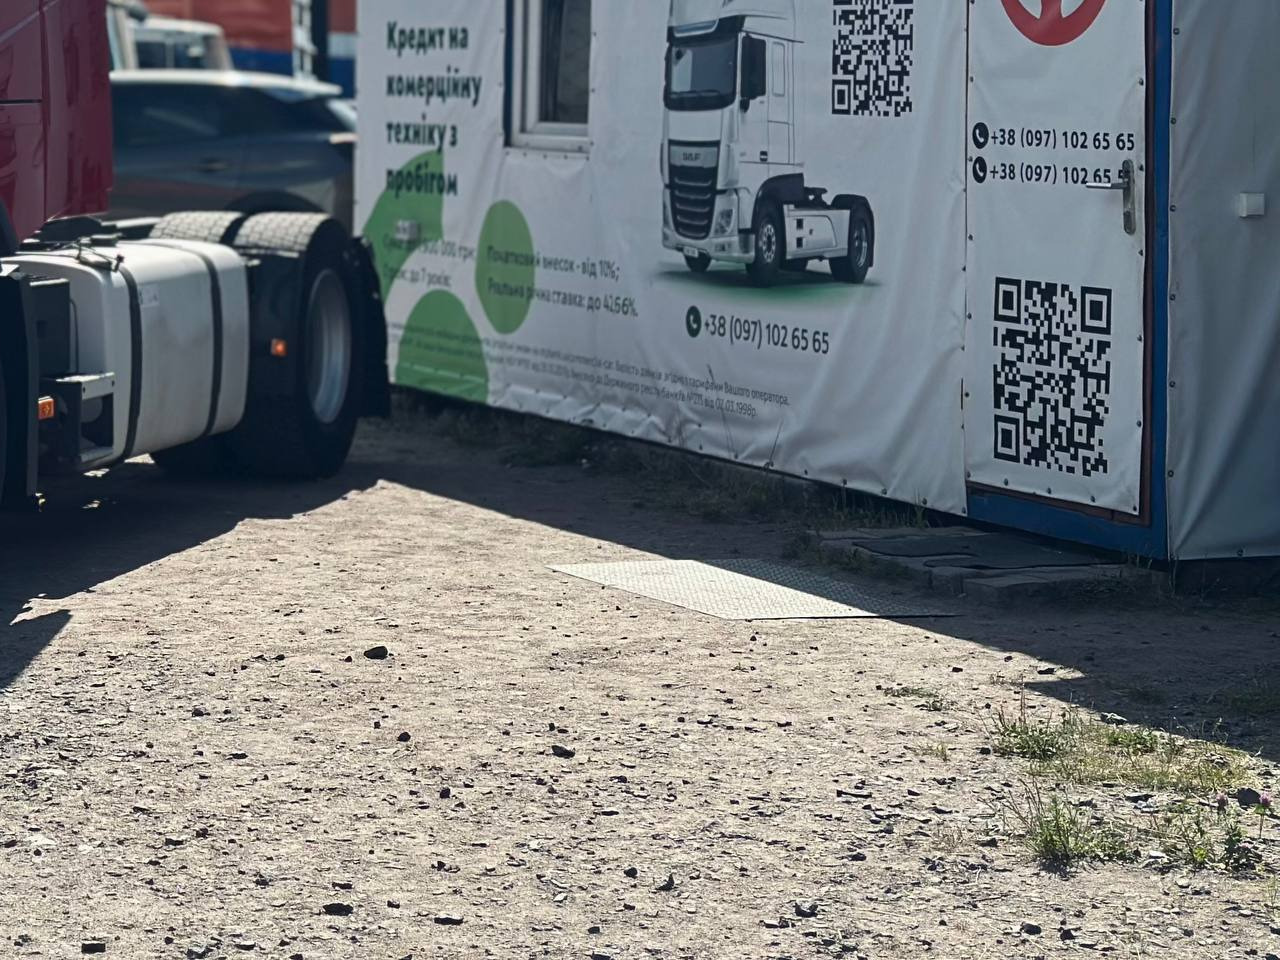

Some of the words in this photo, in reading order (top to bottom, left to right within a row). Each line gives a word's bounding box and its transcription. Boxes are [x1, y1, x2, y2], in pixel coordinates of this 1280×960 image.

[387, 22, 444, 57] Кредит
[449, 26, 469, 49] на
[386, 65, 482, 107] комерційну
[386, 113, 447, 153] техніку
[450, 124, 457, 147] з
[991, 128, 1016, 146] +38
[1020, 127, 1057, 149] (097)
[1062, 131, 1088, 149] 102
[1093, 132, 1110, 150] 65
[1116, 133, 1135, 151] 65
[386, 161, 457, 198] пробігом
[990, 163, 1016, 180] +38
[1020, 162, 1057, 184] (097)
[1062, 167, 1088, 185] 102
[1093, 168, 1111, 183] 65
[704, 313, 726, 337] +38
[730, 315, 762, 350] (097)
[766, 322, 788, 348] 102
[791, 327, 809, 351] 65
[812, 330, 829, 354] 65
